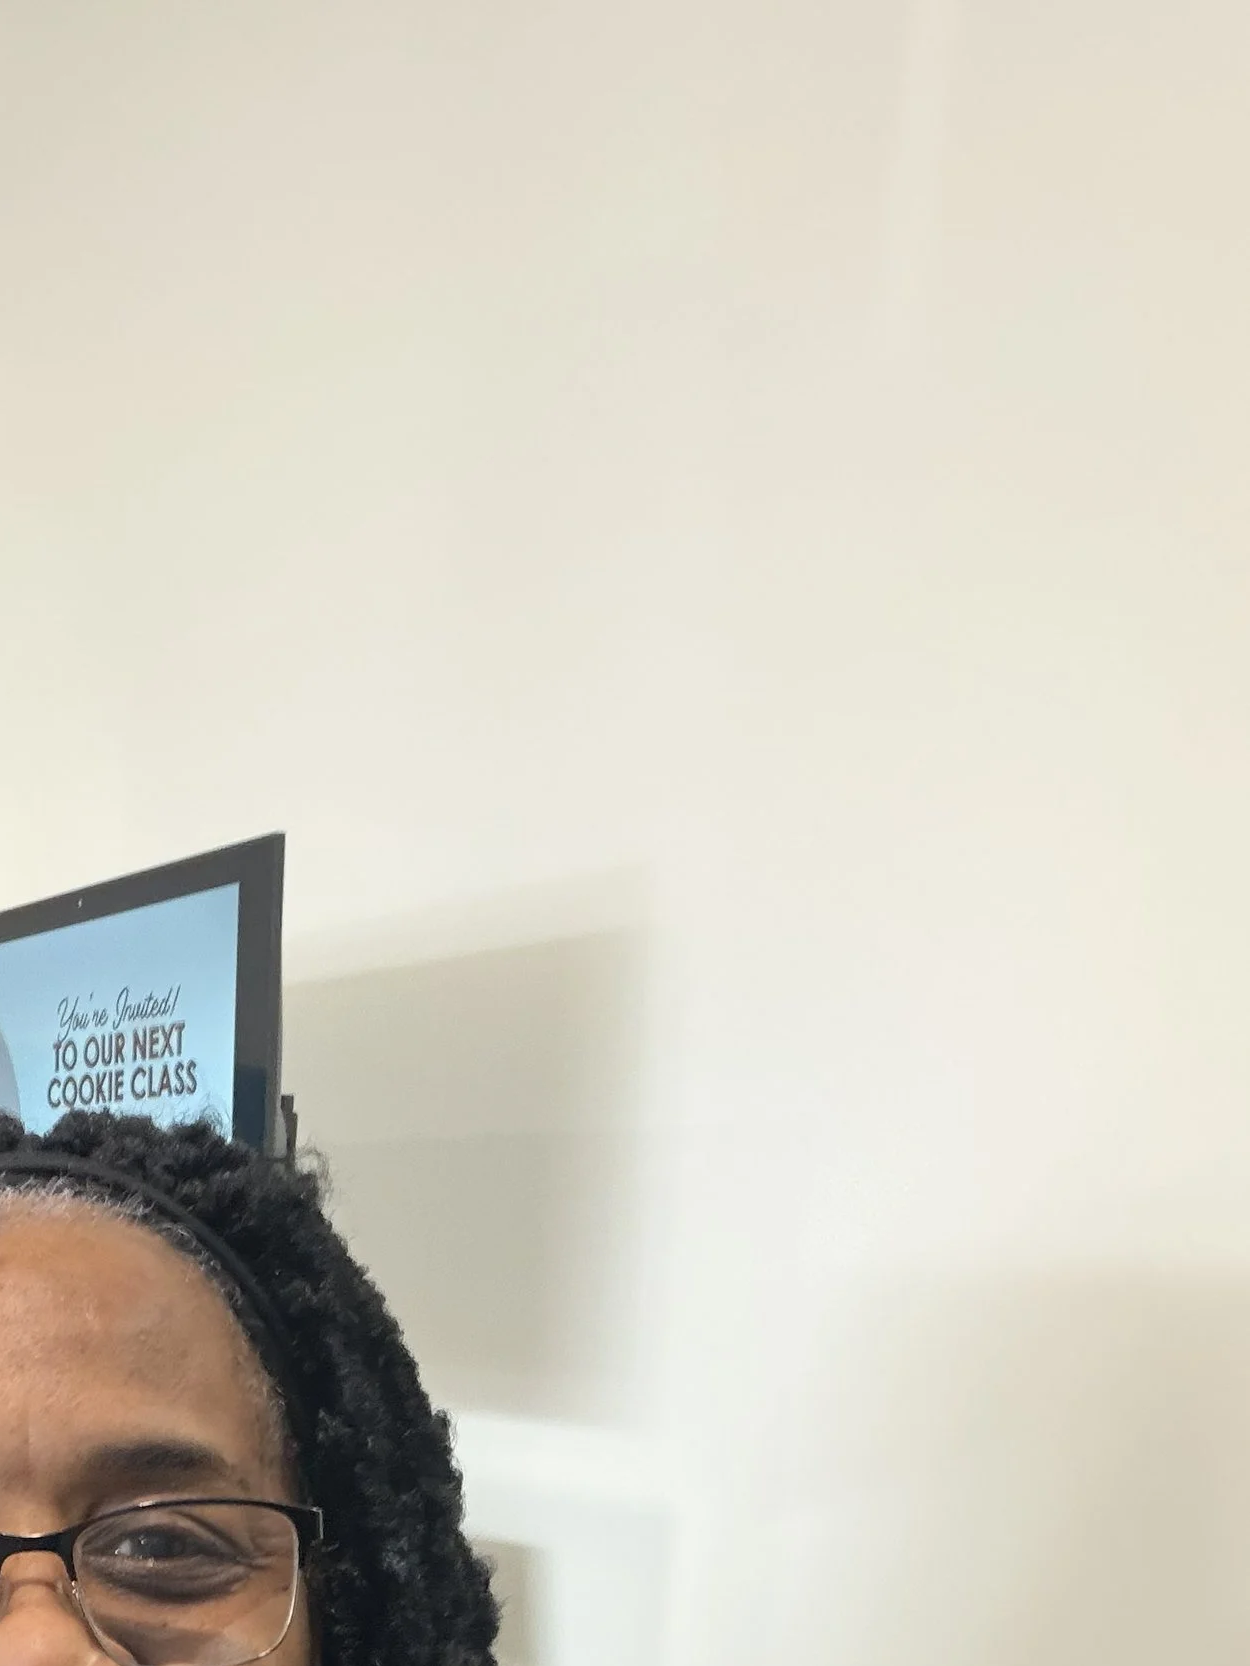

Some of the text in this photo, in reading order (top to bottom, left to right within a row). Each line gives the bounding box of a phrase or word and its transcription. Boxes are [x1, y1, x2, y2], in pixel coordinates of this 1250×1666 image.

[57, 984, 182, 1042] You're Invited!
[53, 1020, 186, 1073] TO OUR NEXT
[47, 1059, 198, 1108] COOKIE CLASS
